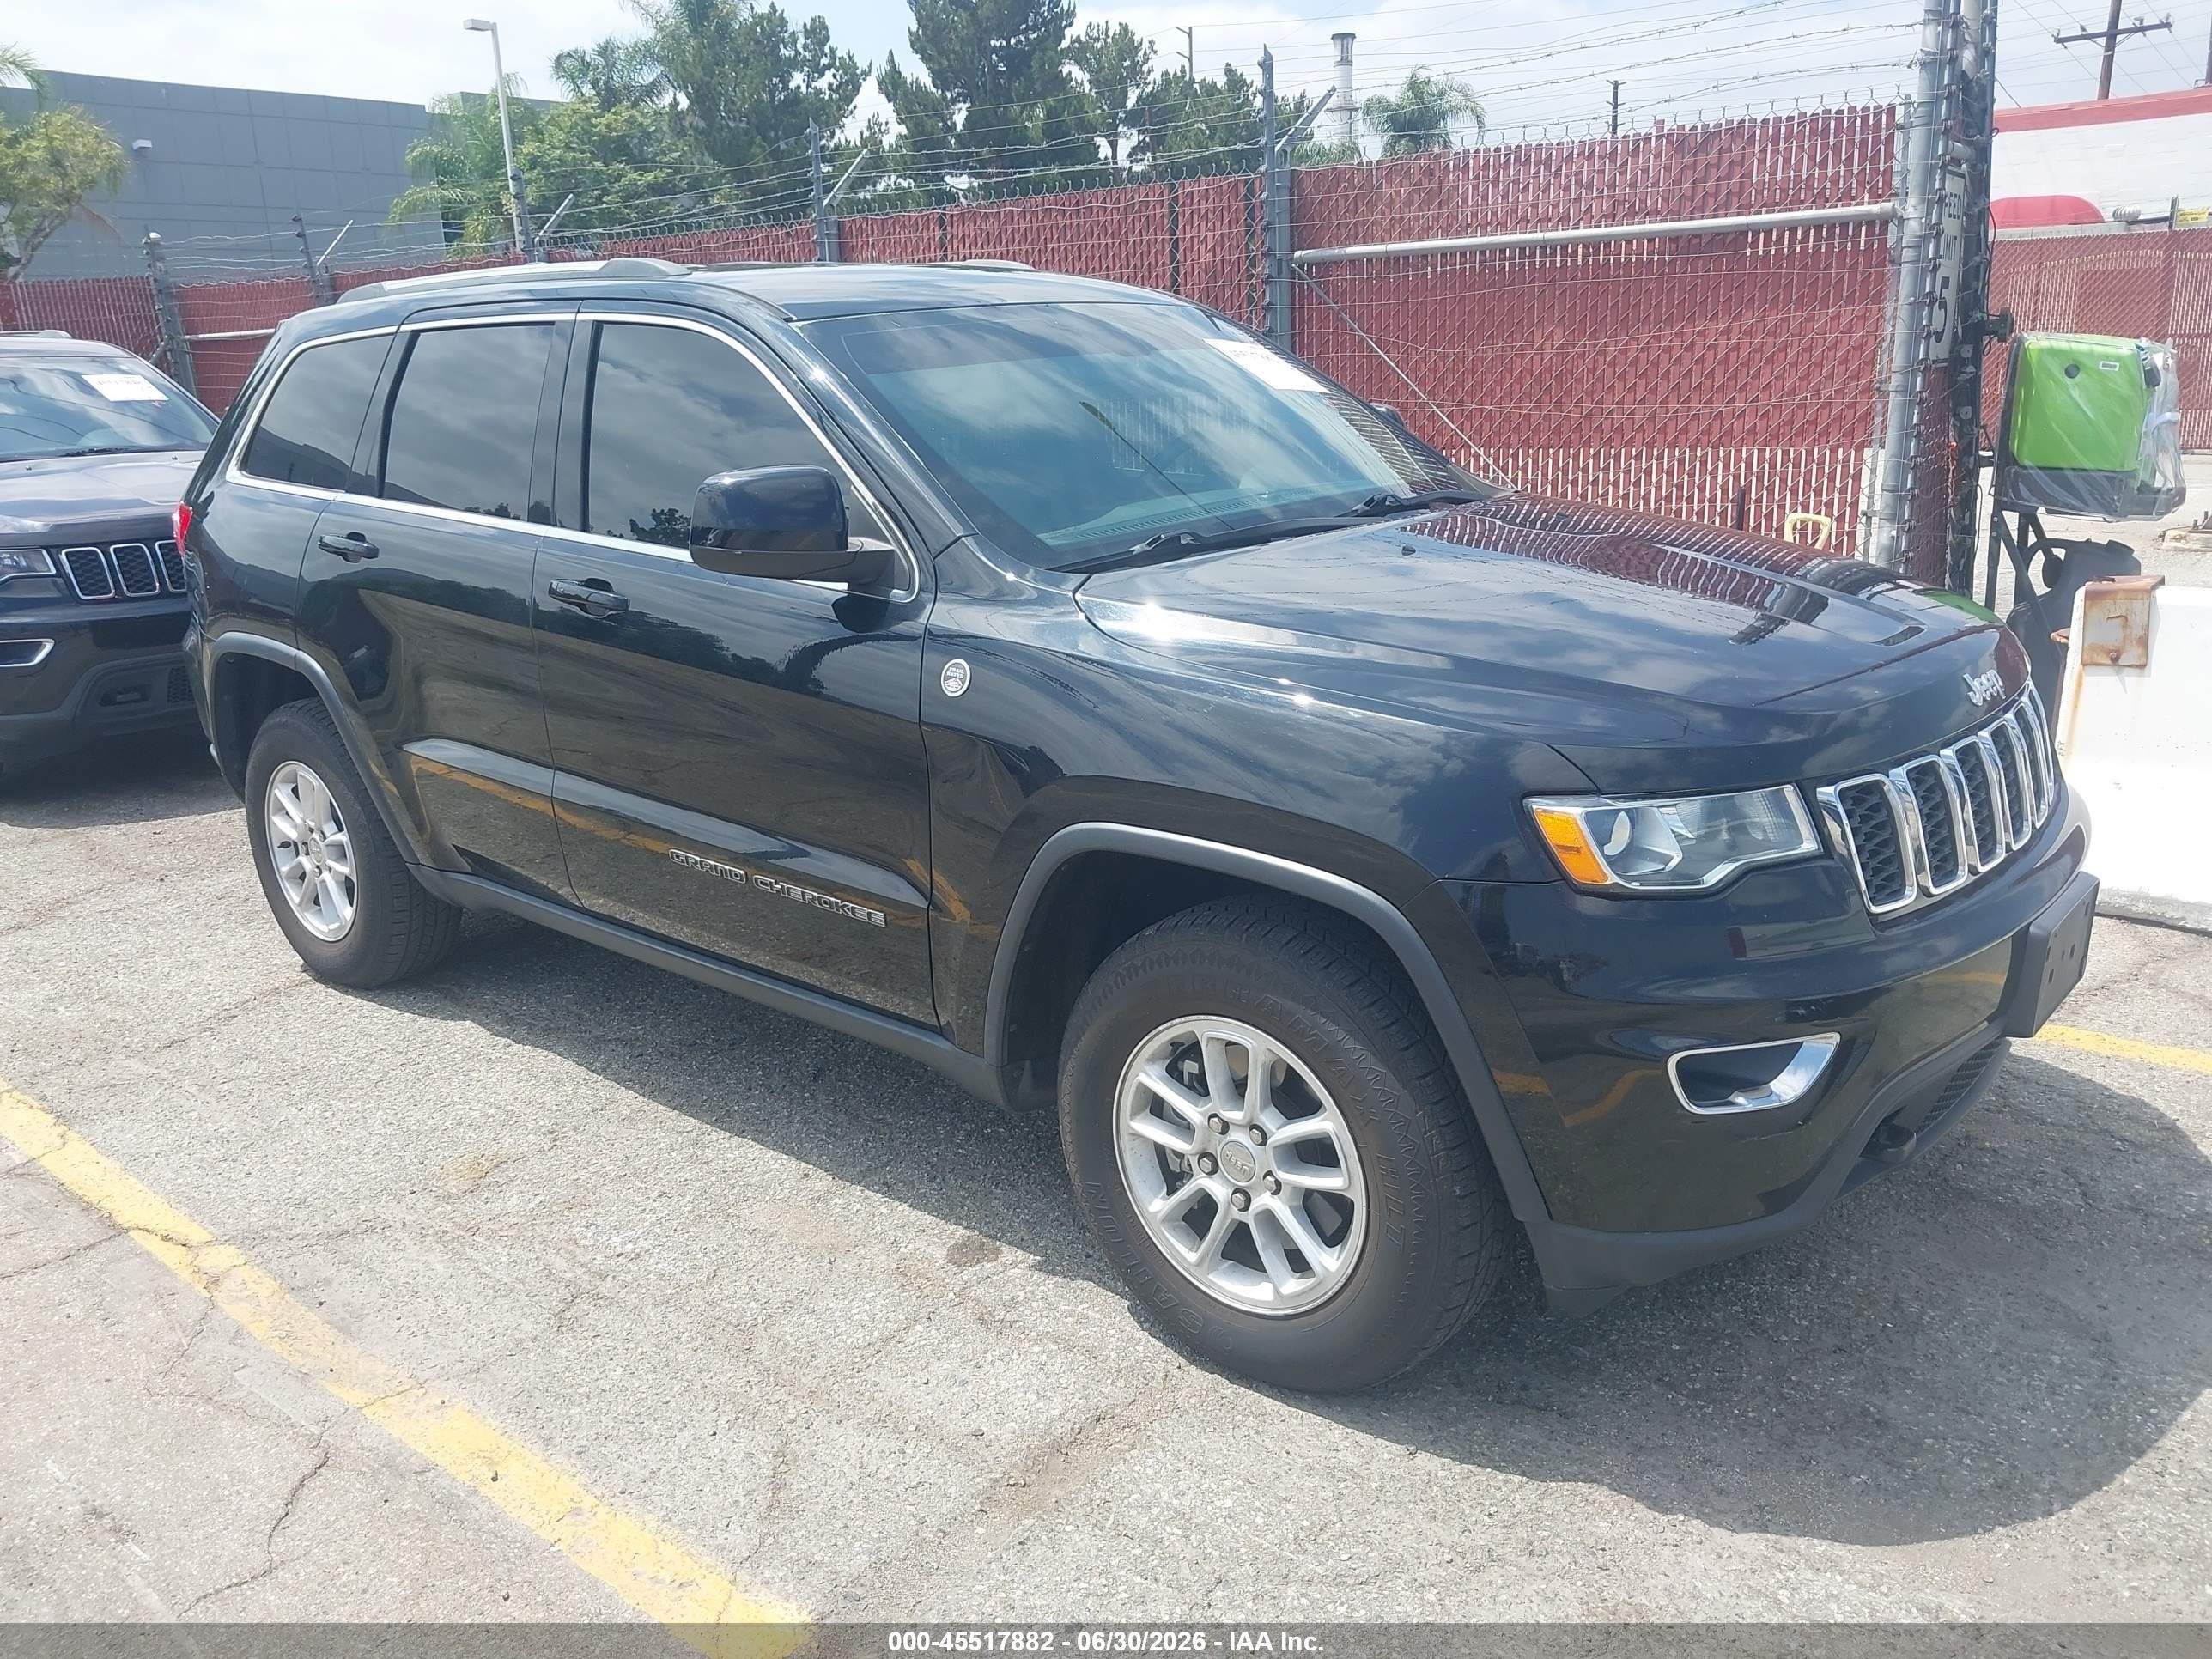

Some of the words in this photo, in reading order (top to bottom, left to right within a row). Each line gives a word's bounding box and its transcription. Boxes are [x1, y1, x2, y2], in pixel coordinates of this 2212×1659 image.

[1943, 191, 1962, 221] PEED
[1942, 233, 1958, 262] IMIT
[1932, 276, 1951, 344] 5
[1962, 669, 2007, 706] Jeep
[668, 848, 747, 884] GRAND
[752, 874, 888, 927] CHEROKEE
